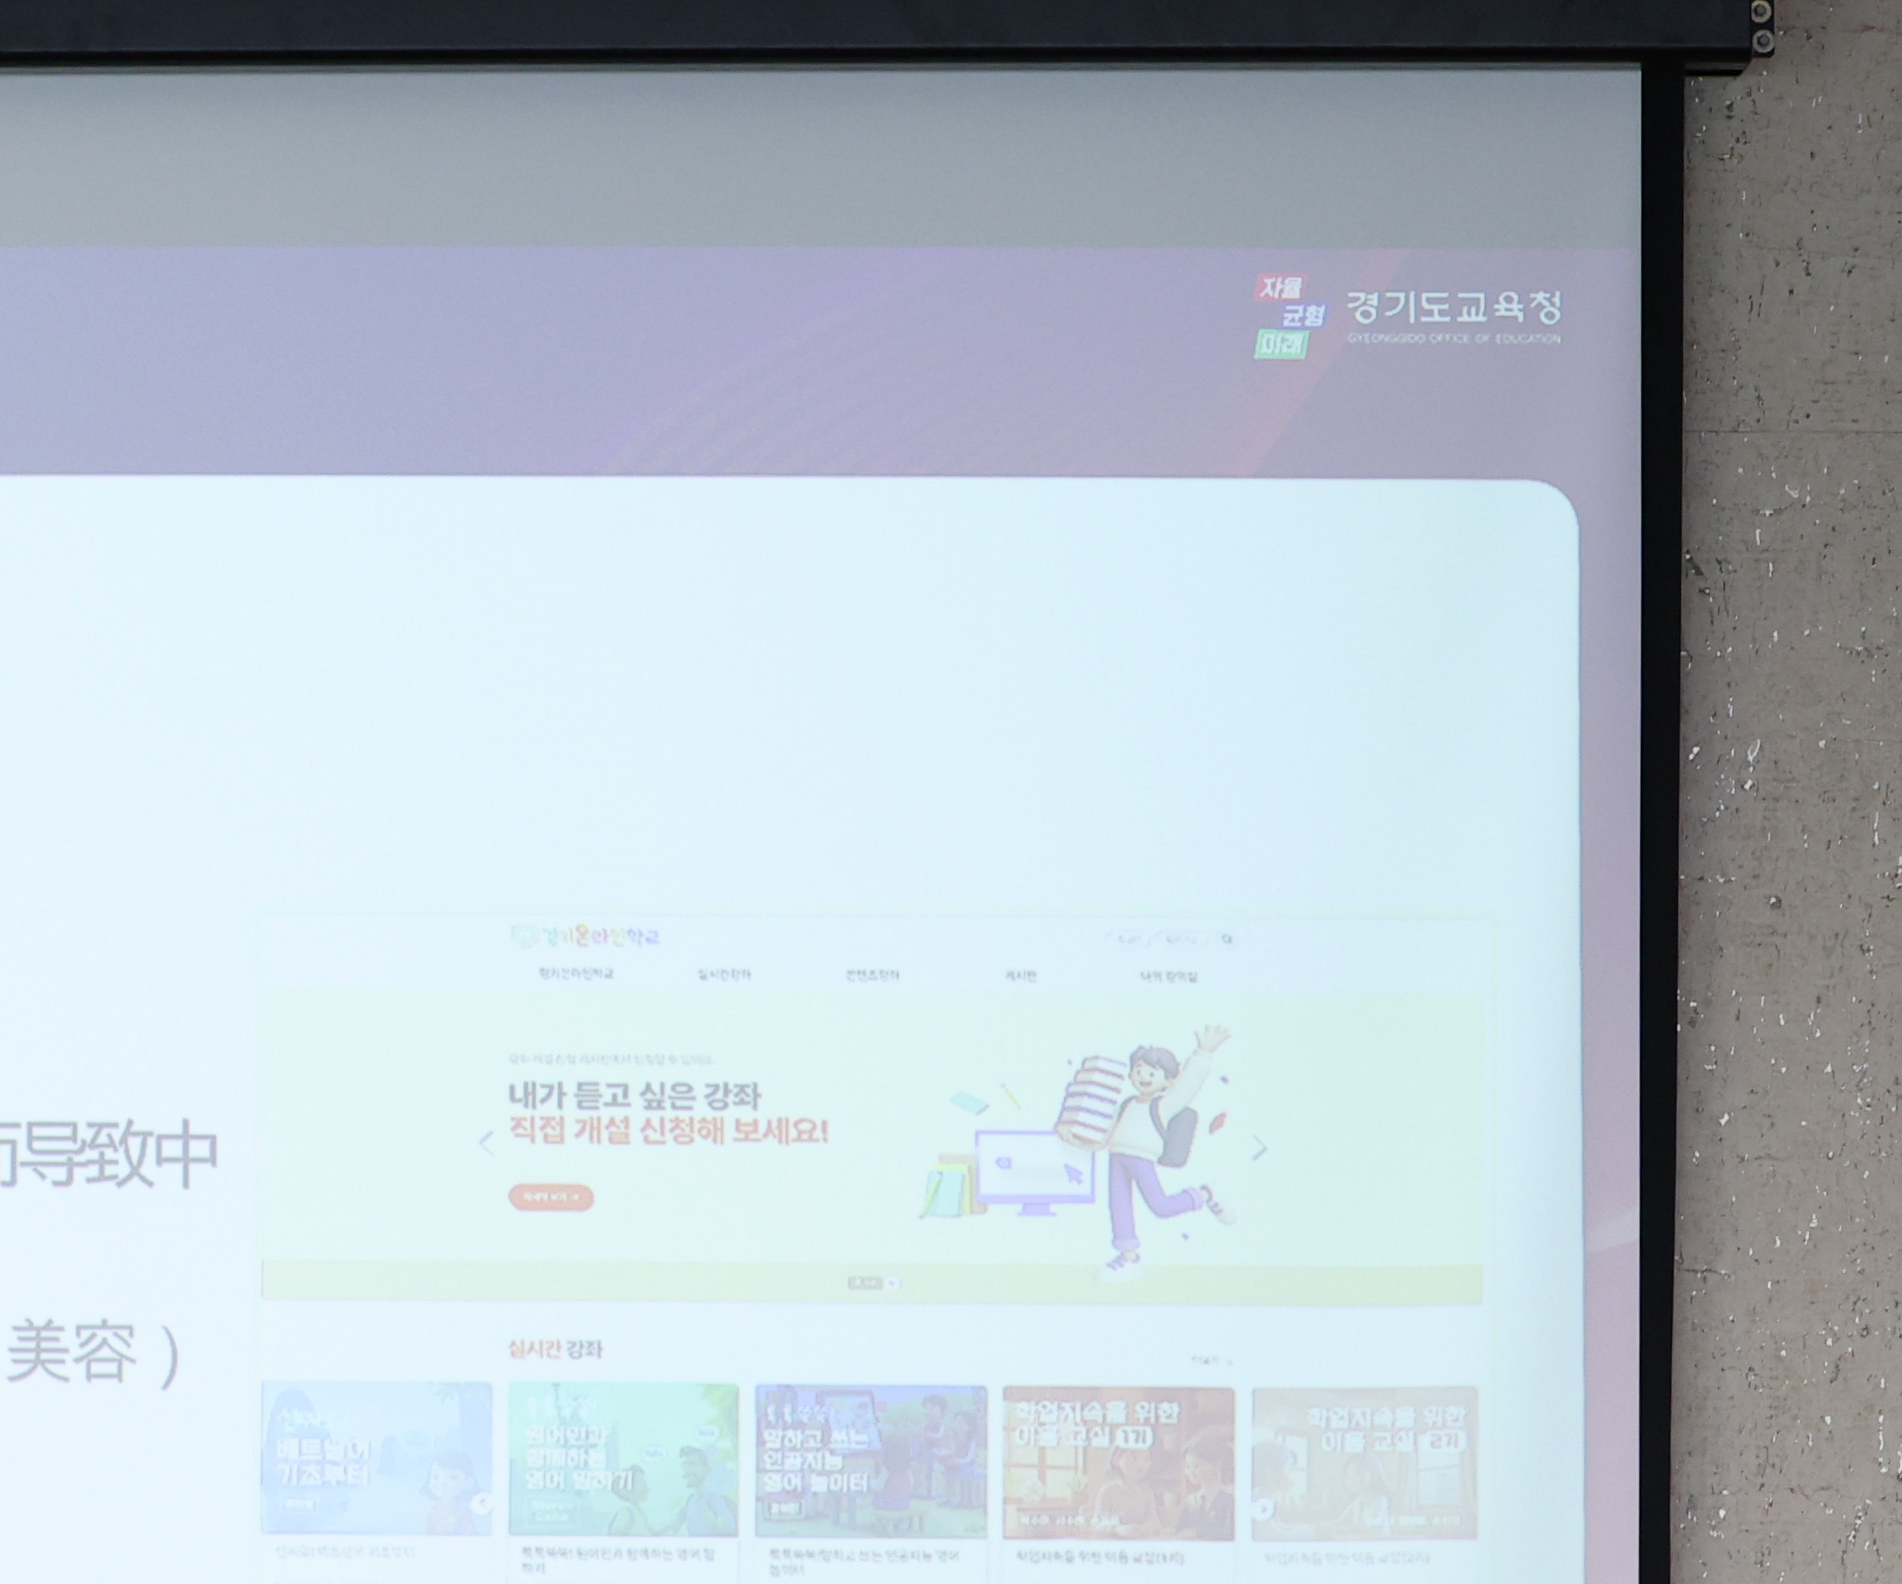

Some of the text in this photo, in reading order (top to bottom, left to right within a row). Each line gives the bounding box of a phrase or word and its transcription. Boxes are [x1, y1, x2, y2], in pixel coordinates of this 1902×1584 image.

[1346, 290, 1563, 326] 경기도교육청
[507, 1081, 763, 1112] 내가 듣고 싶은 강좌
[508, 1116, 830, 1146] 직접 개설 신청해 보세요!
